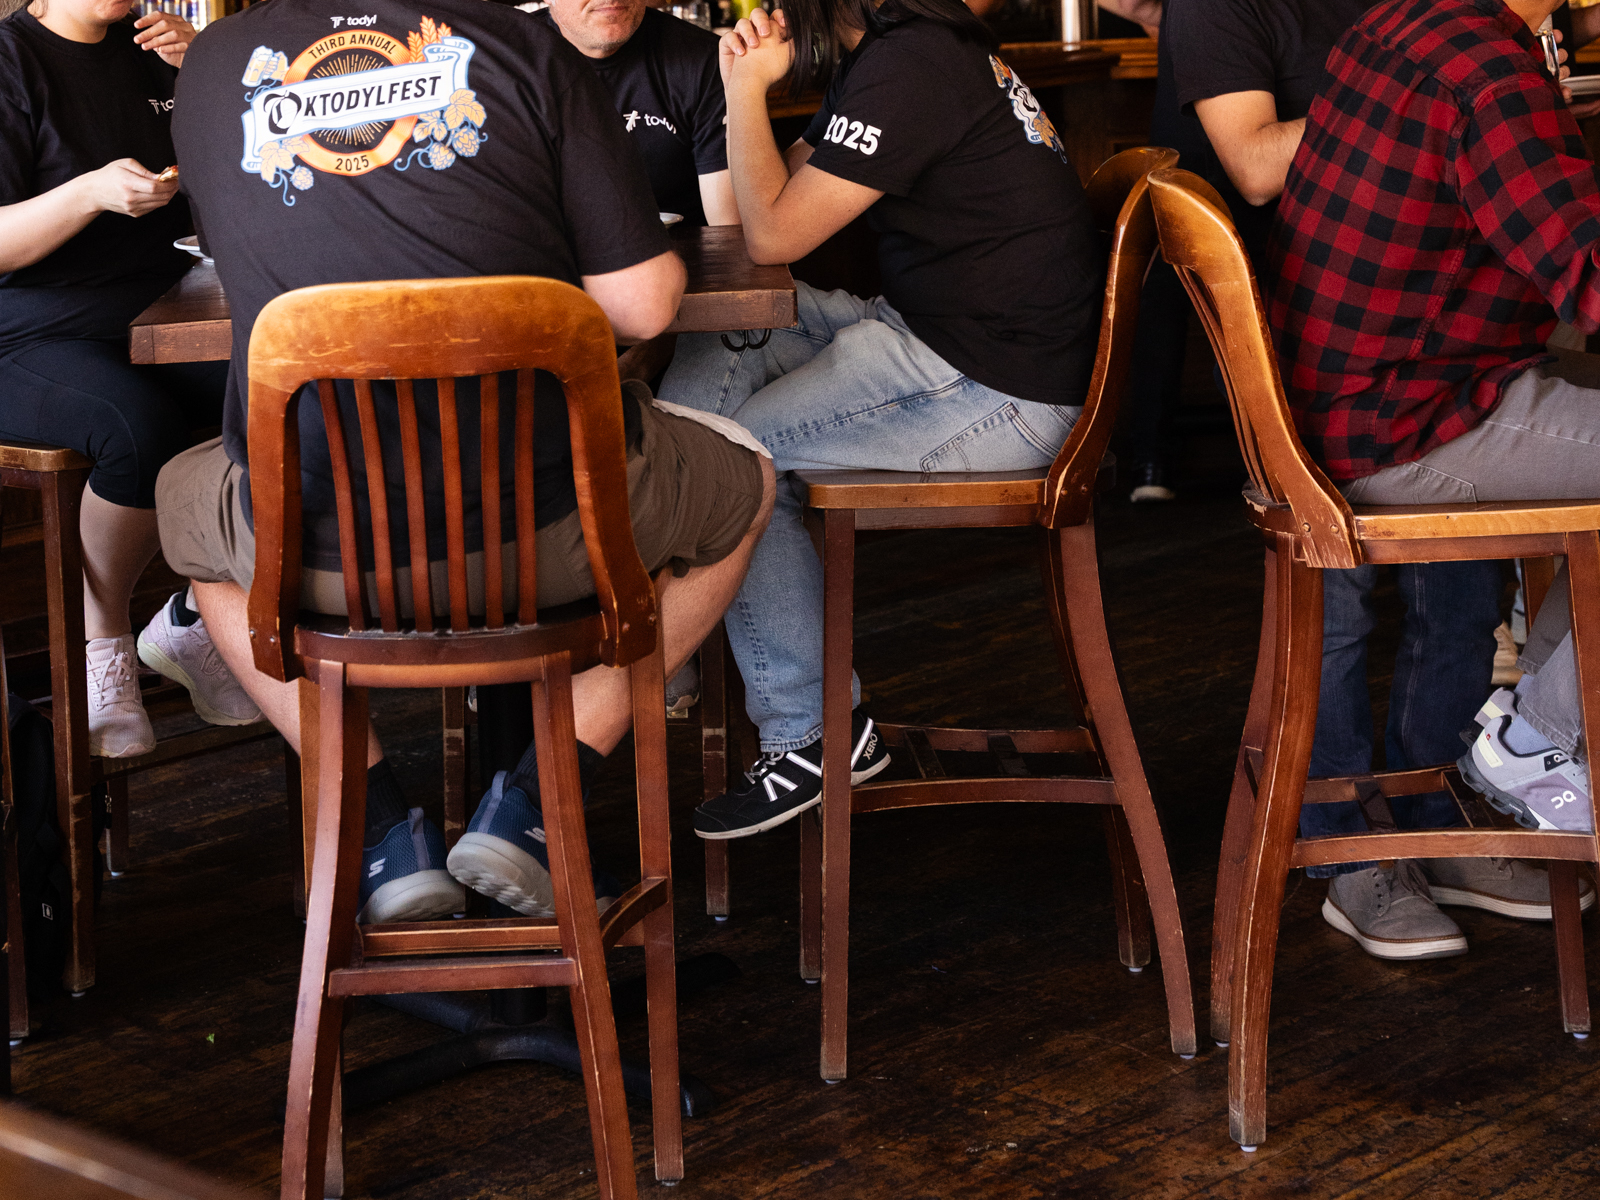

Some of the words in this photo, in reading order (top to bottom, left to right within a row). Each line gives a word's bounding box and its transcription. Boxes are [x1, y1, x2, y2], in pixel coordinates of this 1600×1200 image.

[346, 14, 377, 27] todyl
[307, 36, 346, 60] THIRD
[349, 34, 397, 56] ANNUAL
[334, 154, 370, 172] 2025
[862, 732, 879, 761] XERO
